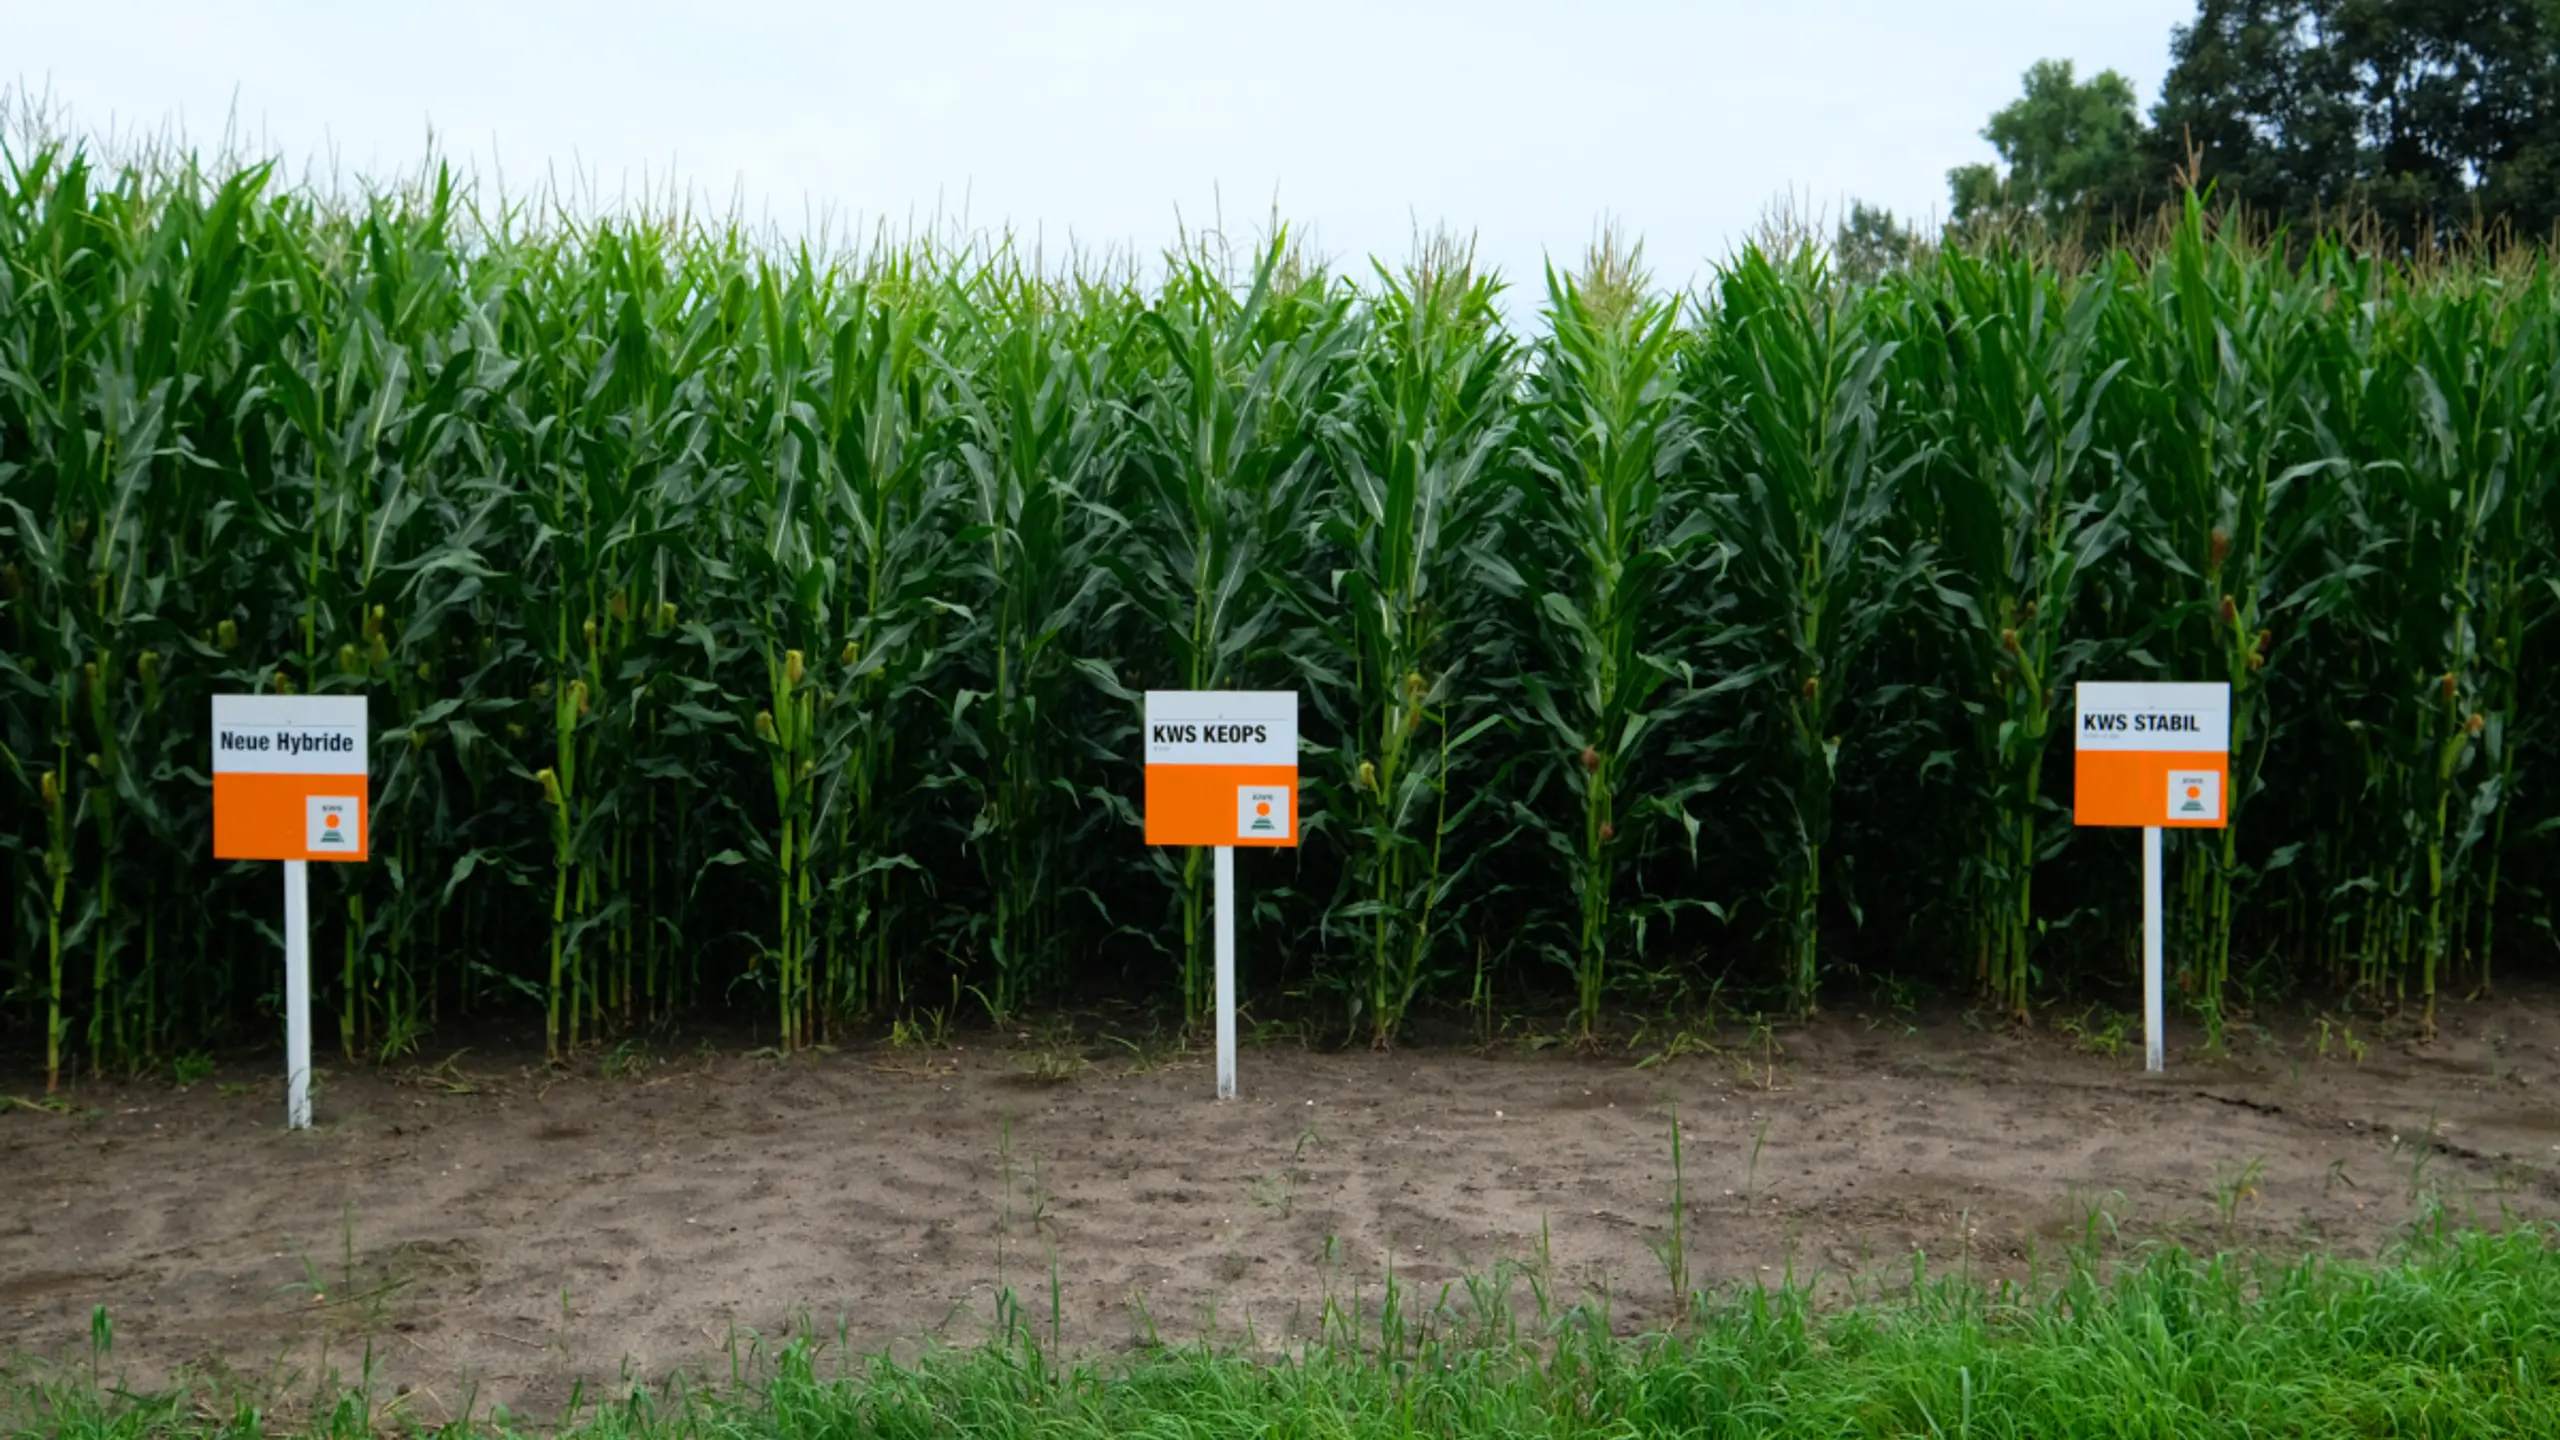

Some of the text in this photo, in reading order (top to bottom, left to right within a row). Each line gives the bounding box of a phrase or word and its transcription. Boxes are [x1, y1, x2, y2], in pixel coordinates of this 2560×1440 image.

[2083, 713, 2201, 732] KWS STABIL
[220, 731, 354, 756] Neue Hybride
[1153, 724, 1267, 744] KWS KEOPS
